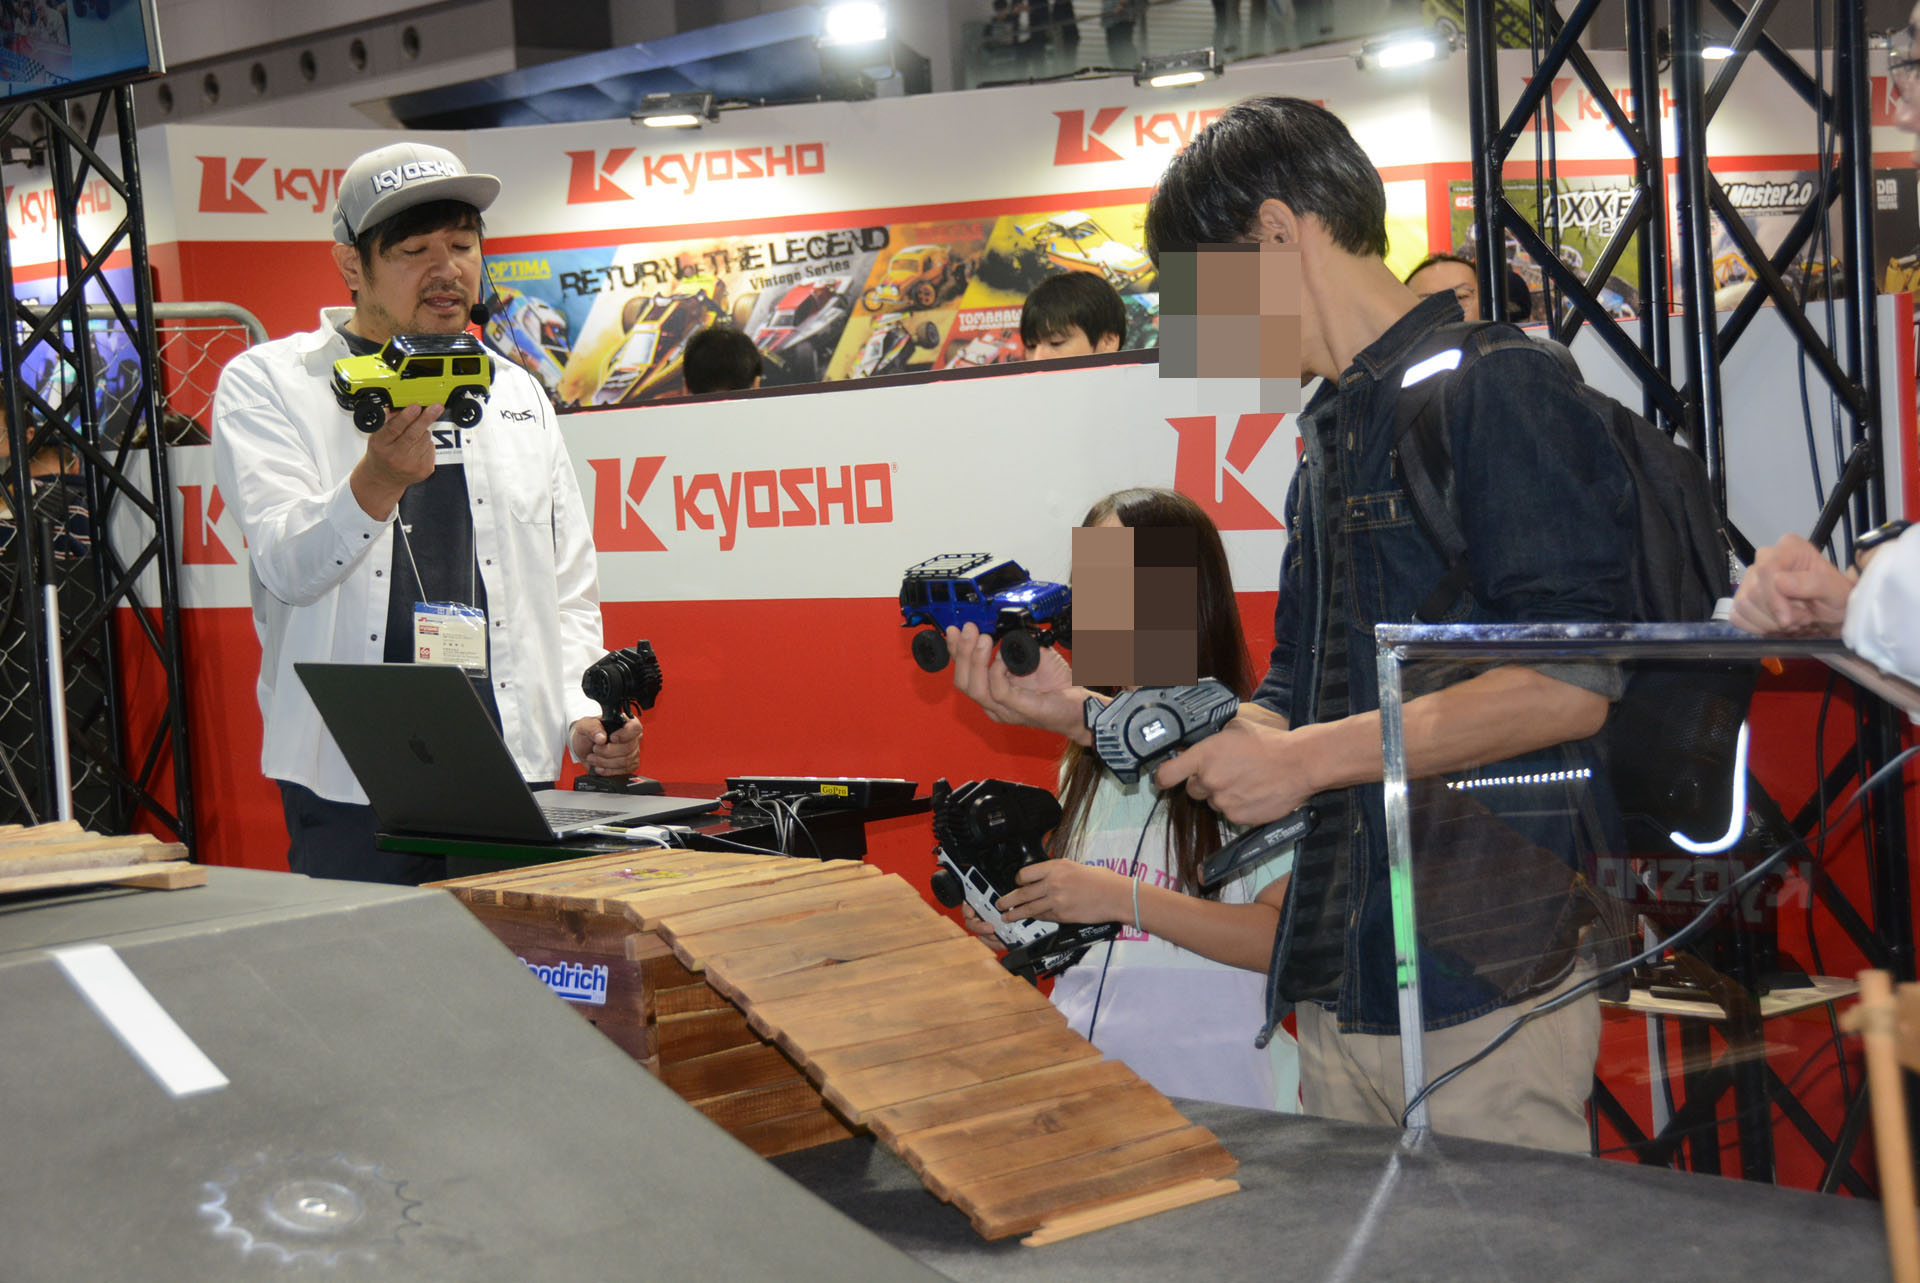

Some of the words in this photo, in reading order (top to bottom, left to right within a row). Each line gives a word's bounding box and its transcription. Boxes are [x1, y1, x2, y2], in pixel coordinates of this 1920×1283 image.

[371, 160, 459, 194] KYOSHO
[643, 142, 825, 195] KYOSHO
[487, 259, 551, 279] OPTIMA
[560, 255, 682, 298] RETURN
[703, 243, 765, 276] THE
[769, 225, 890, 266] LEGEND
[750, 269, 802, 291] Vintage
[804, 259, 850, 279] Series
[672, 462, 893, 551] KYOSHO
[822, 786, 847, 795] GoPro
